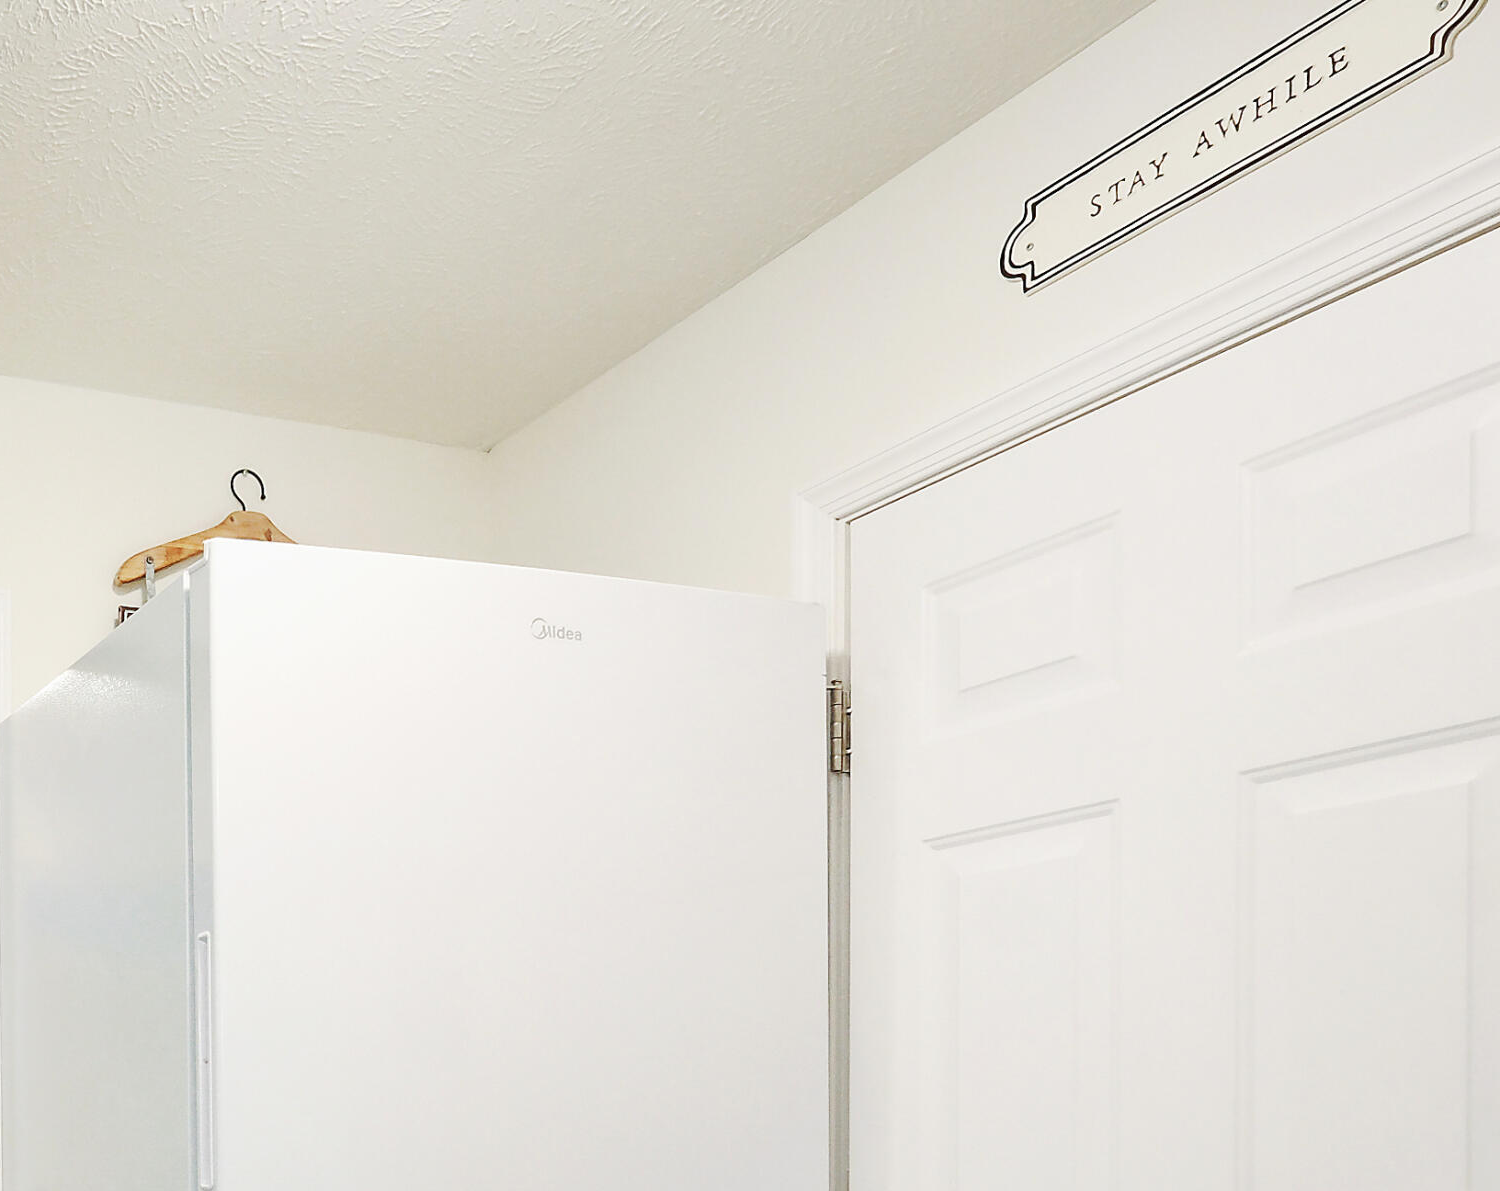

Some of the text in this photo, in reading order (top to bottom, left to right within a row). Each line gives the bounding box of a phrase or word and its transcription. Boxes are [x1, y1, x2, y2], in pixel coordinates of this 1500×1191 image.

[1089, 46, 1351, 218] STAY AWHILE
[530, 617, 582, 641] Midea
